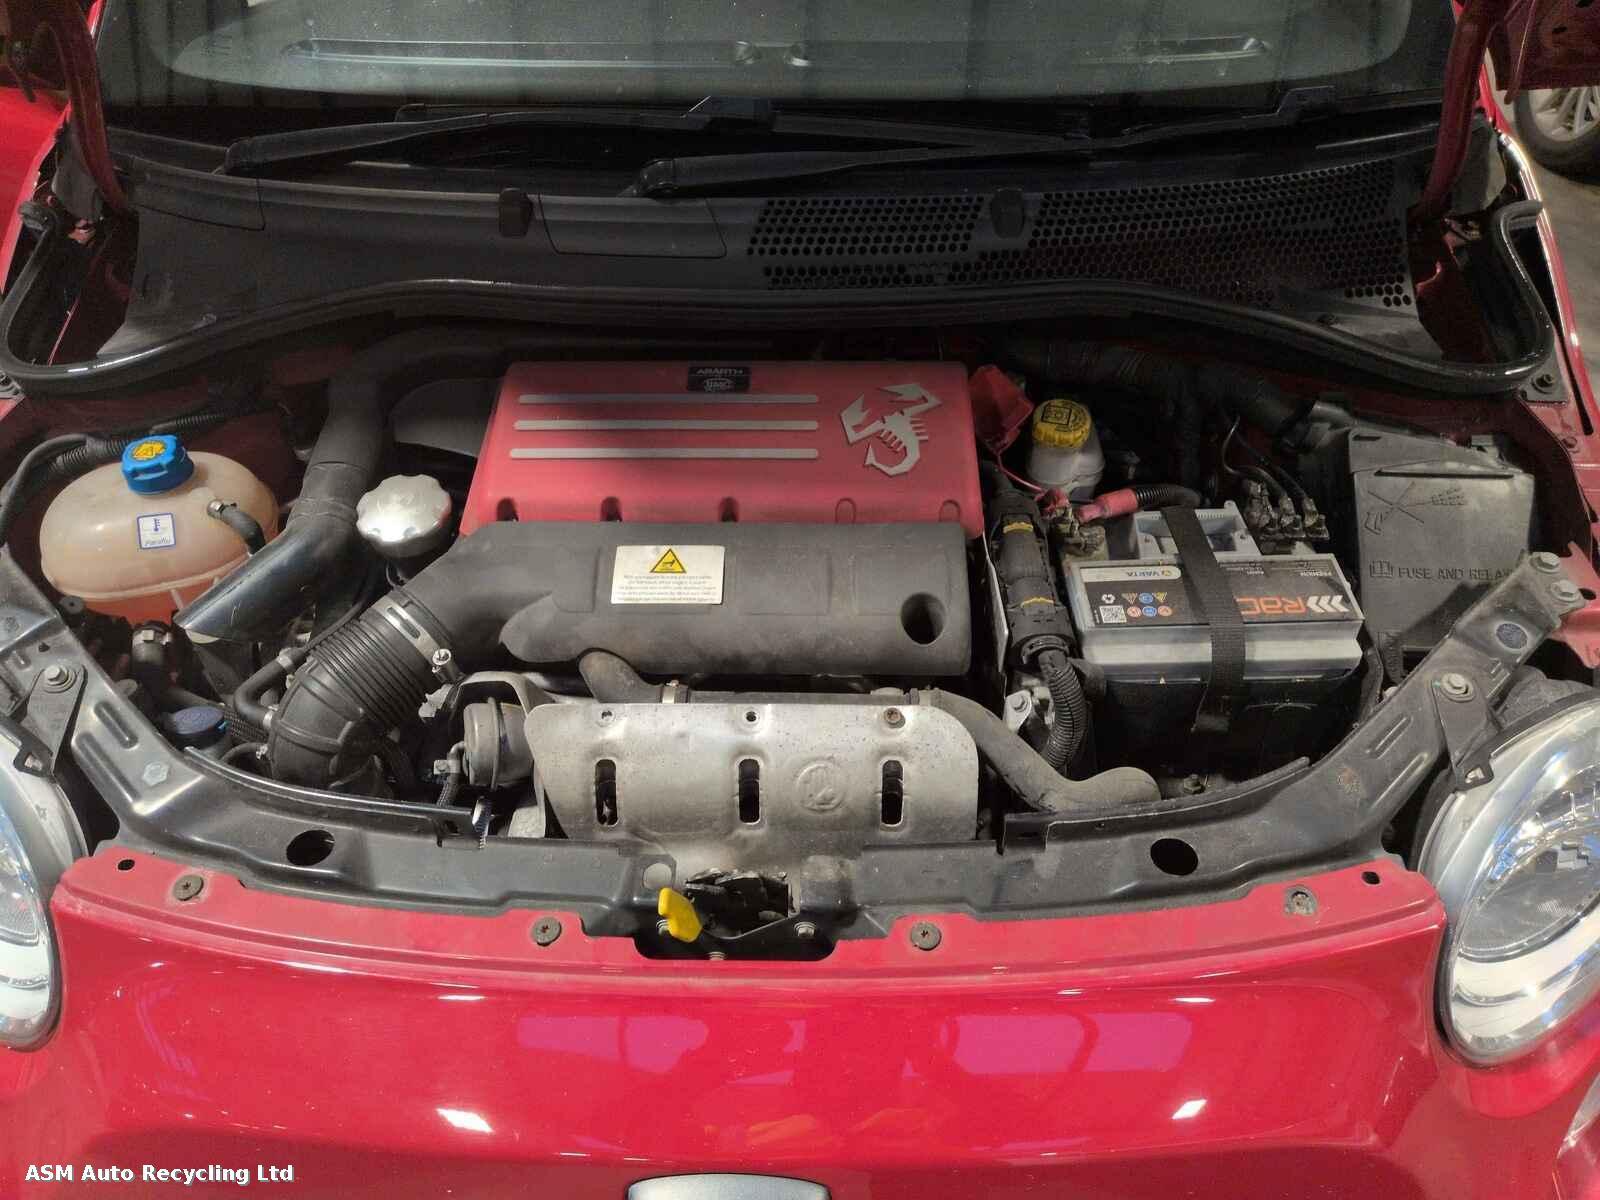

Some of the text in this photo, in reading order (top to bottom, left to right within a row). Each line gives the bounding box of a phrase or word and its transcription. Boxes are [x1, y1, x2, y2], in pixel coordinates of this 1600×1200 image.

[697, 367, 743, 375] ABARTH
[1398, 567, 1431, 579] FUSE
[1437, 568, 1465, 579] AND
